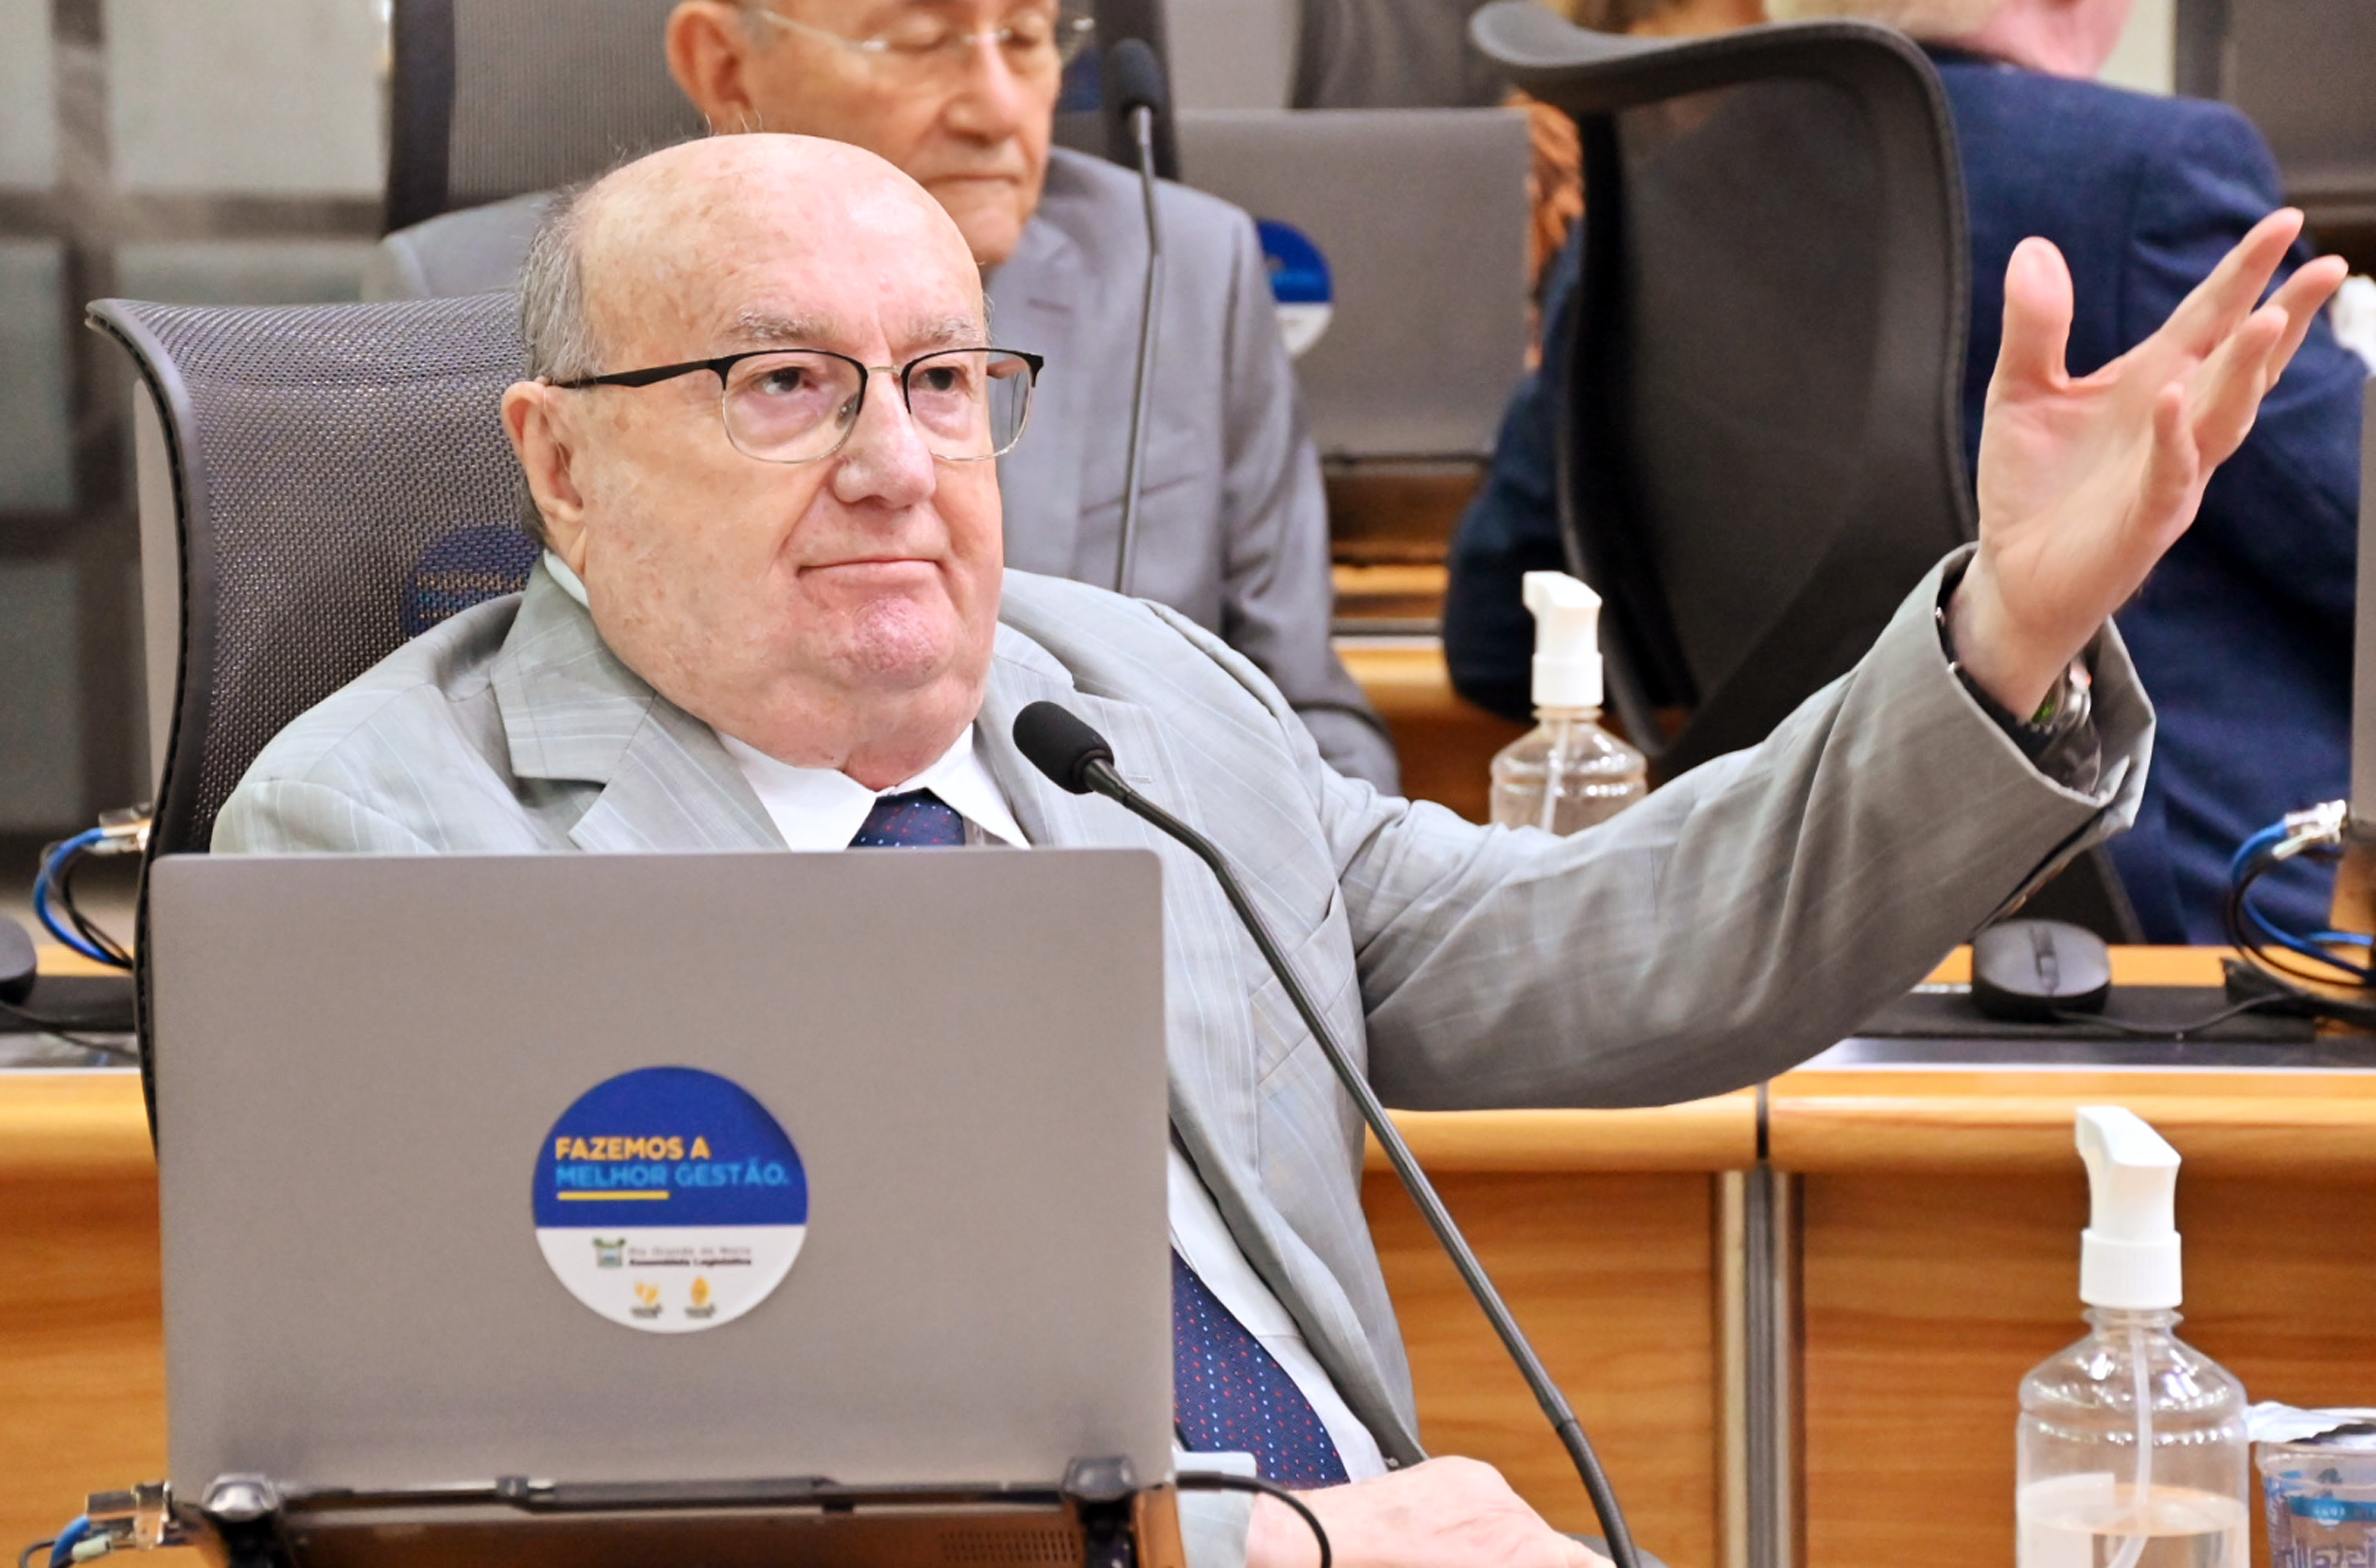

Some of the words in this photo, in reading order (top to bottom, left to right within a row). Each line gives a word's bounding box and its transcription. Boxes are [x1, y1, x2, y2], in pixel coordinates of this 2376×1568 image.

[556, 1136, 684, 1160] FAZEMOS
[690, 1136, 712, 1159] A
[556, 1164, 667, 1187] MELHOR
